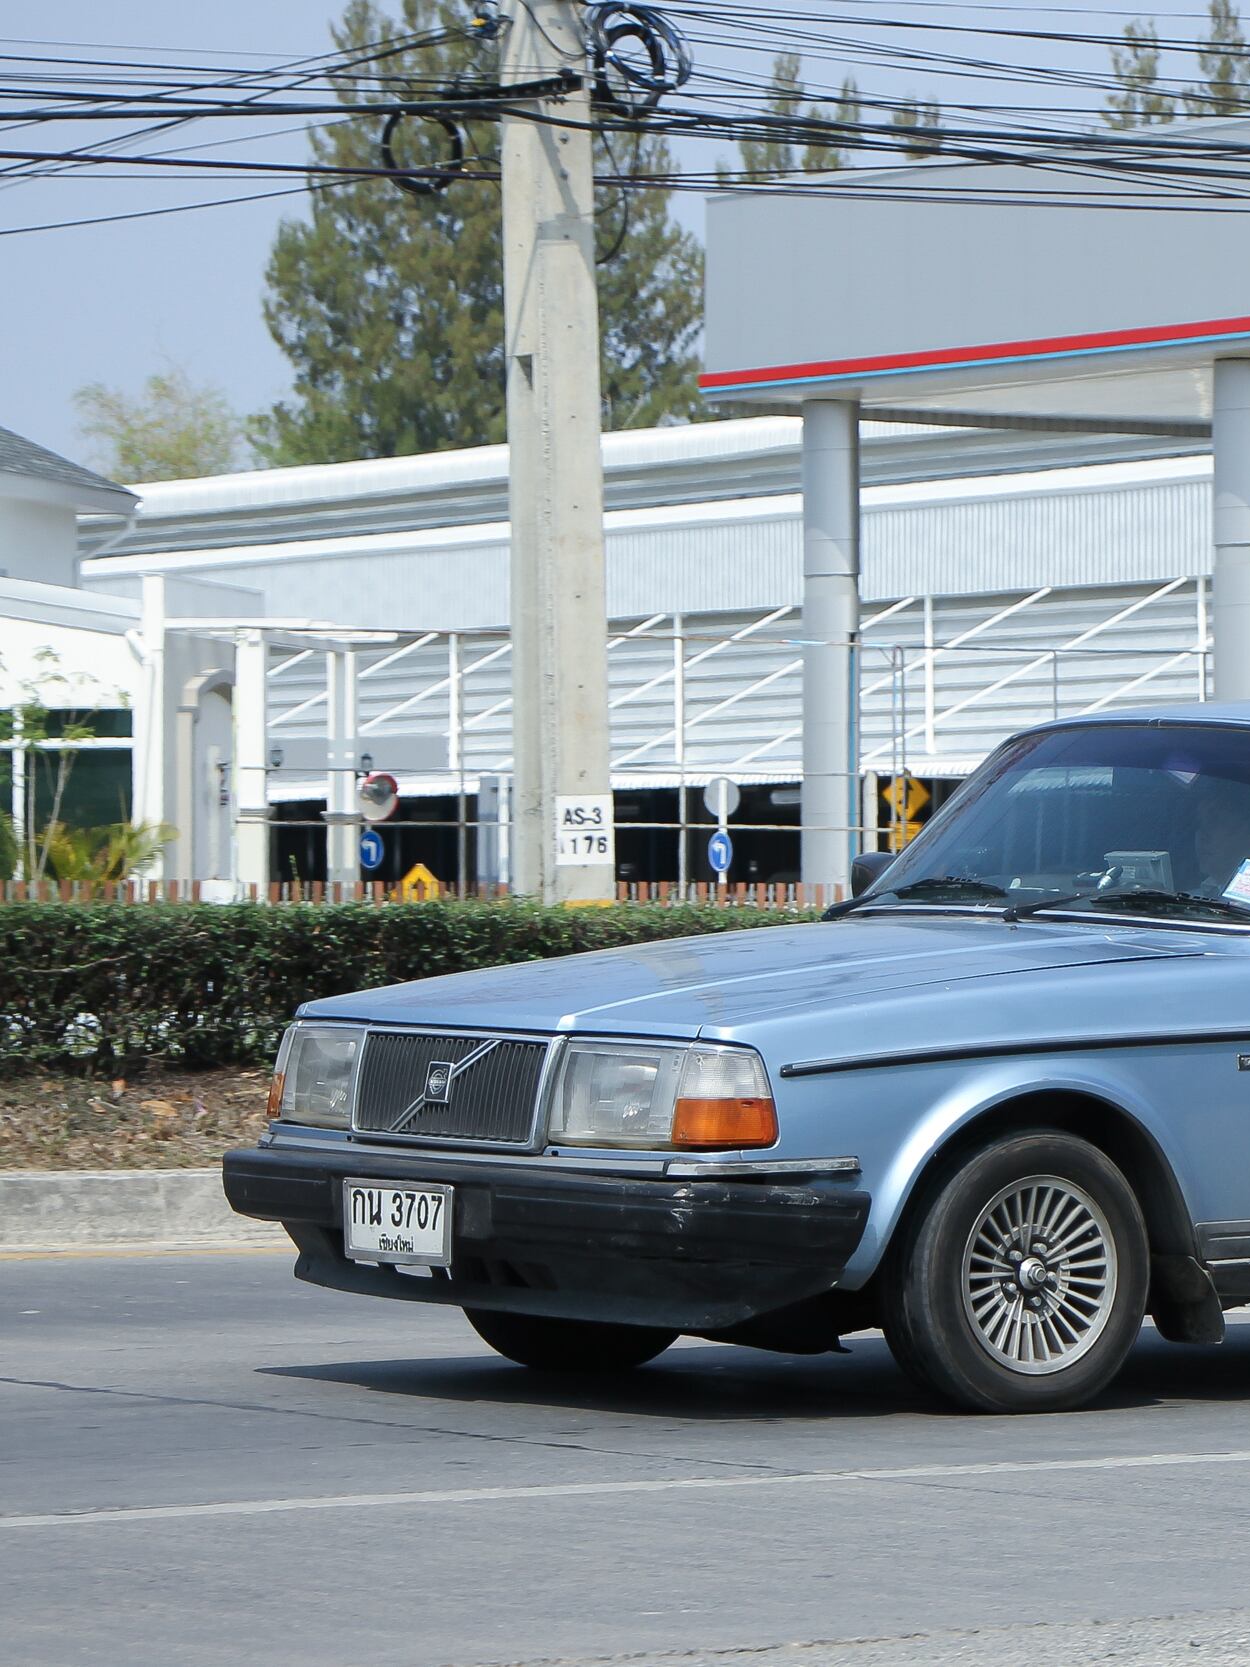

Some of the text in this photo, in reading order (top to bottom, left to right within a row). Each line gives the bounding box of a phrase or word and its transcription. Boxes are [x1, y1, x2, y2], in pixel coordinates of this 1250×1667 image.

[563, 807, 602, 825] AS-3
[352, 1189, 443, 1231] กน 3707
